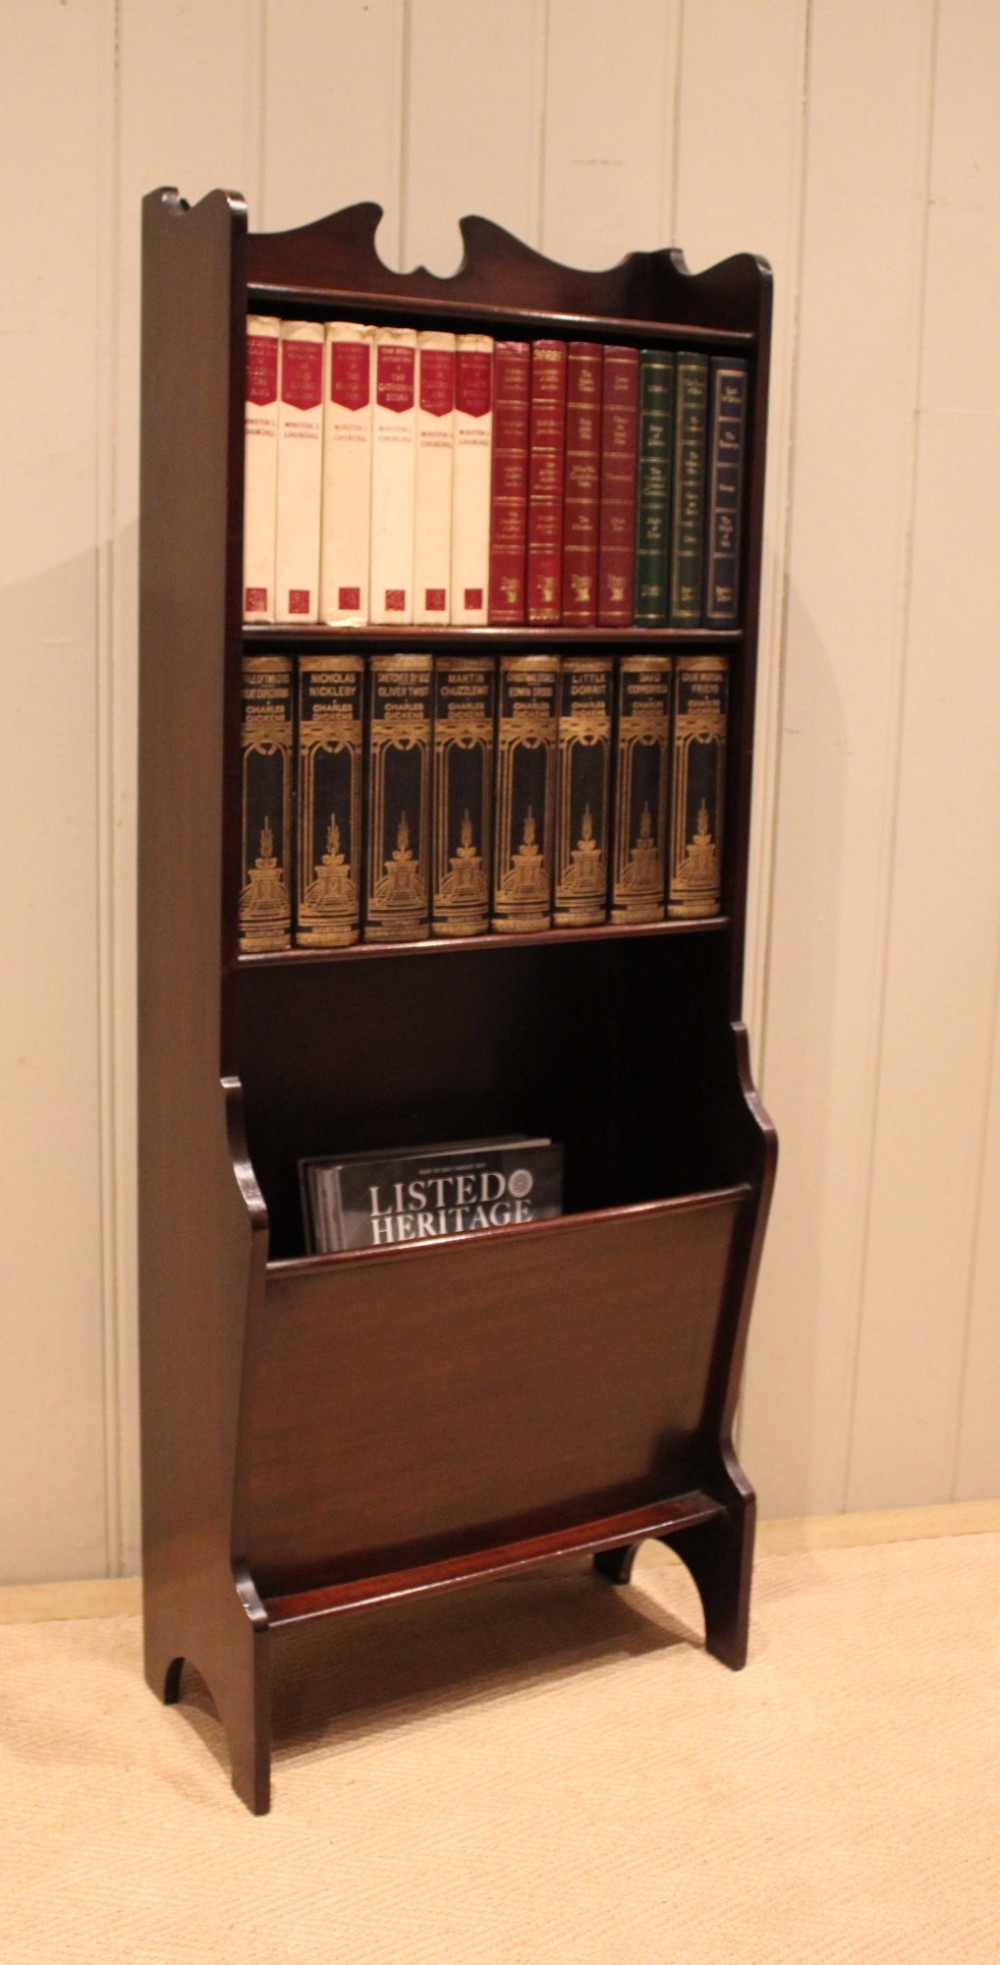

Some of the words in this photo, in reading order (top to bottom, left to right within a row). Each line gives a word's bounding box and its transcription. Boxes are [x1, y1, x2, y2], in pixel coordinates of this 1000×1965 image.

[311, 673, 356, 684] NICHOLAS
[447, 673, 485, 683] MARTIN
[571, 672, 606, 683] LITTLE
[309, 686, 357, 697] NICKLEBY
[378, 686, 407, 697] OLIVER
[571, 685, 606, 696] DORRIT
[245, 704, 285, 714] CHARLES
[312, 703, 353, 712] CHARLES
[384, 702, 424, 711] CHARLES
[447, 702, 485, 711] CHARLES
[369, 1171, 506, 1217] LISTED
[370, 1199, 533, 1245] HERITAGE
